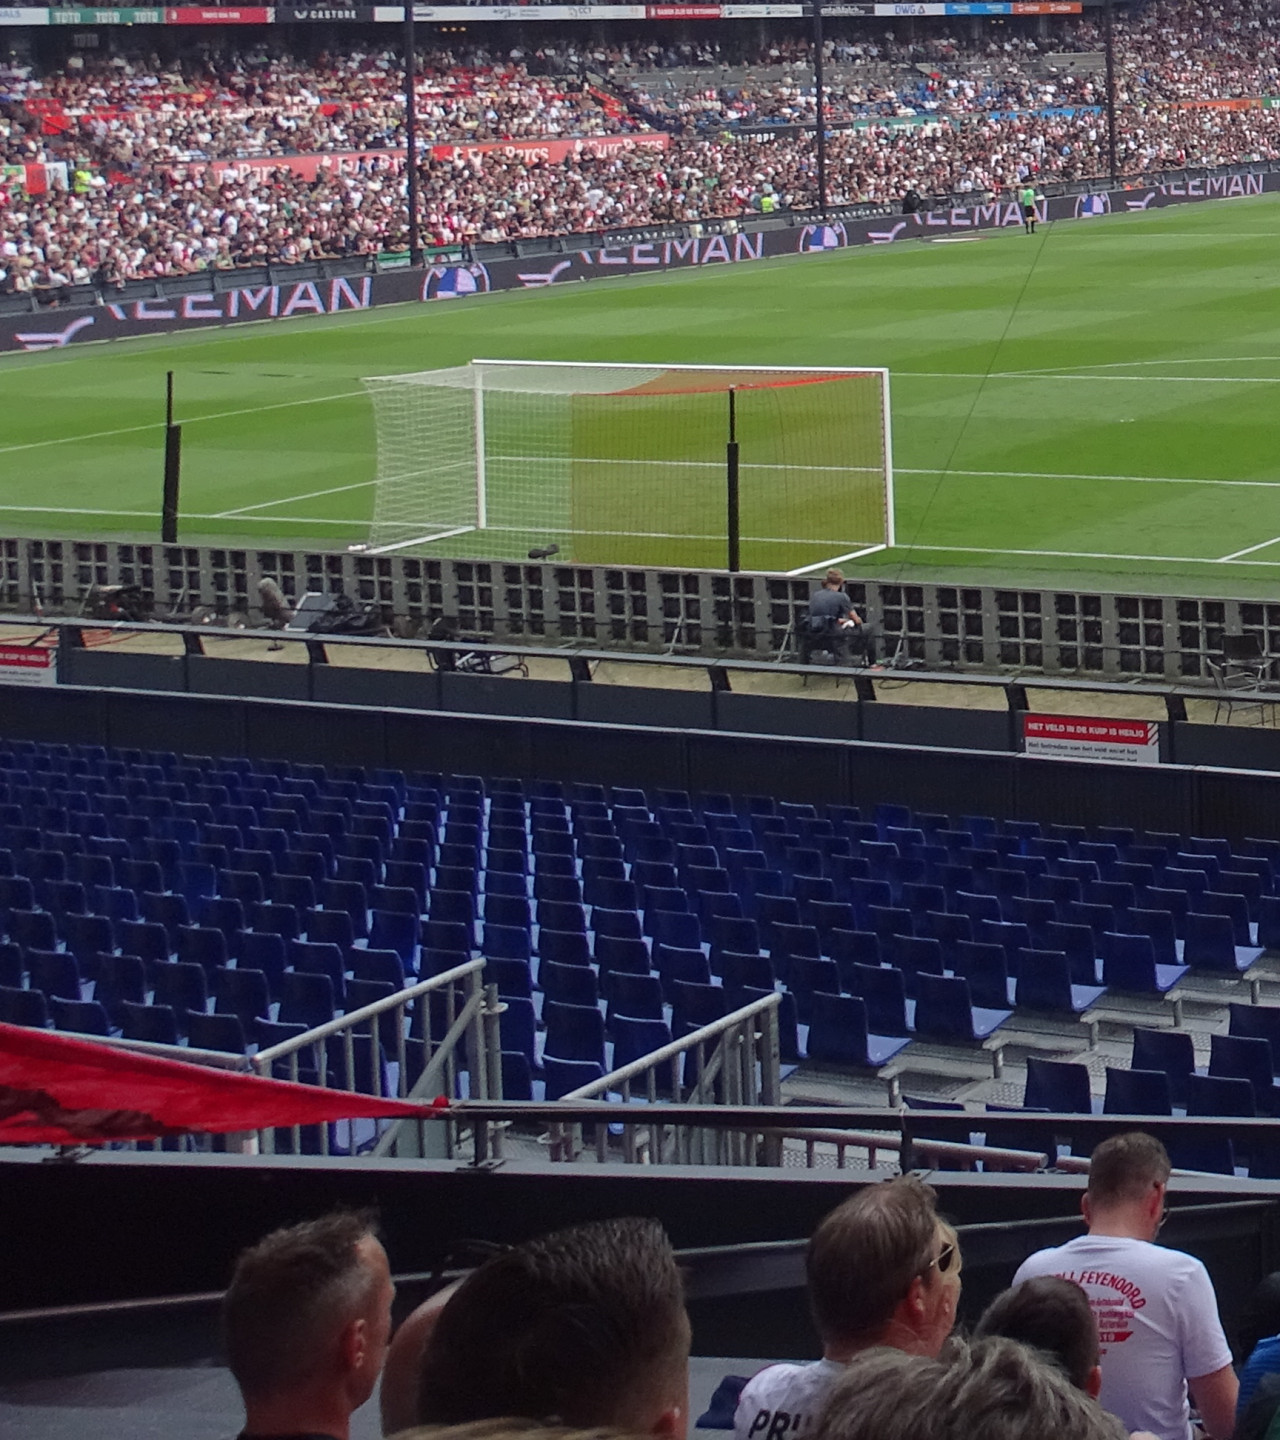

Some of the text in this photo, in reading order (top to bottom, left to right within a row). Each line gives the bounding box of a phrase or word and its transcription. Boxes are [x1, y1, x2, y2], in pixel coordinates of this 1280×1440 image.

[310, 10, 356, 19] CASTORE
[1028, 722, 1043, 731] HET
[1045, 724, 1064, 733] VELD
[1076, 726, 1087, 734] DE
[1089, 727, 1108, 735] KUIP
[1118, 729, 1144, 738] HEILIG
[1079, 1271, 1147, 1310] FEYENOORD
